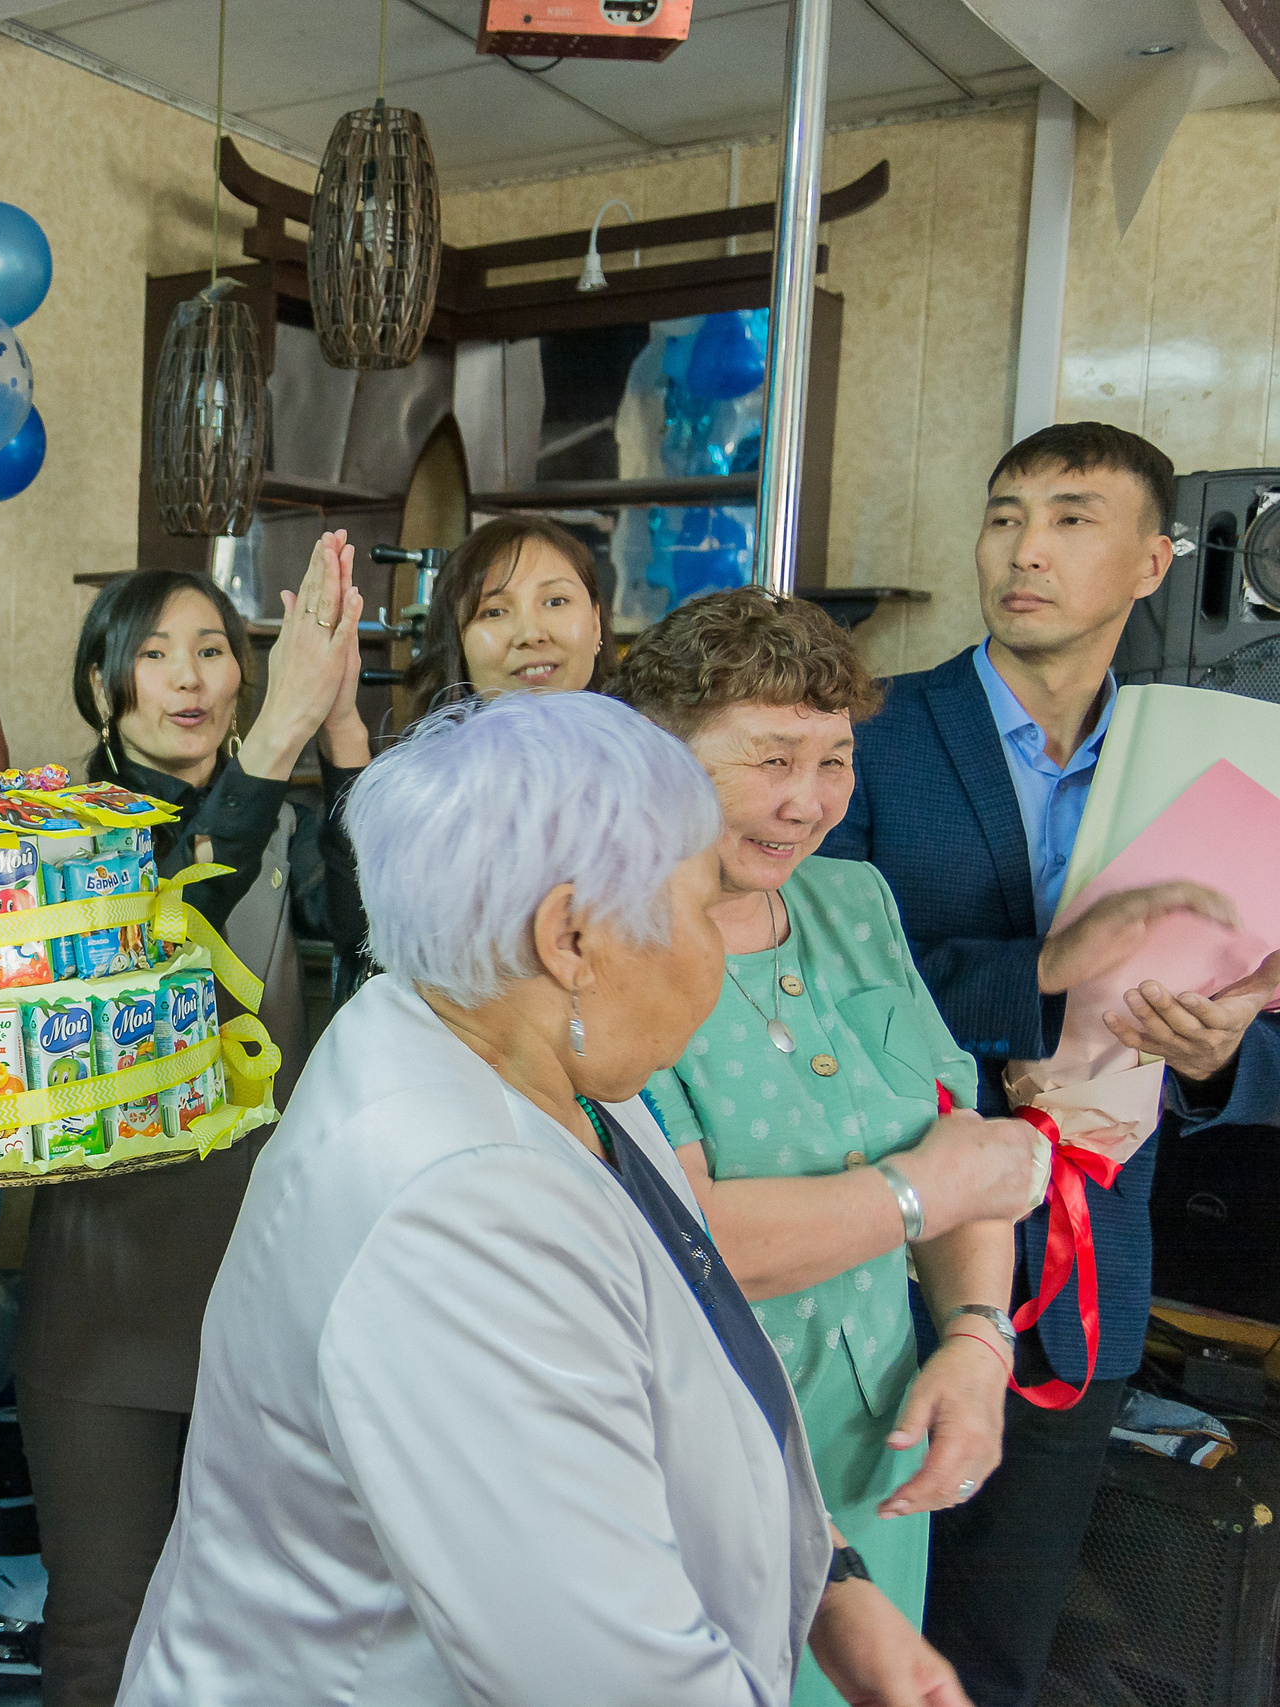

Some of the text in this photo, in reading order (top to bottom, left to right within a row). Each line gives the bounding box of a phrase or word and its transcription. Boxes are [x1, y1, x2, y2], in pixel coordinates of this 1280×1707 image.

[86, 874, 119, 890] Барни
[113, 1005, 153, 1040] Мой
[173, 993, 198, 1027] Мой
[42, 1014, 88, 1047] Мой
